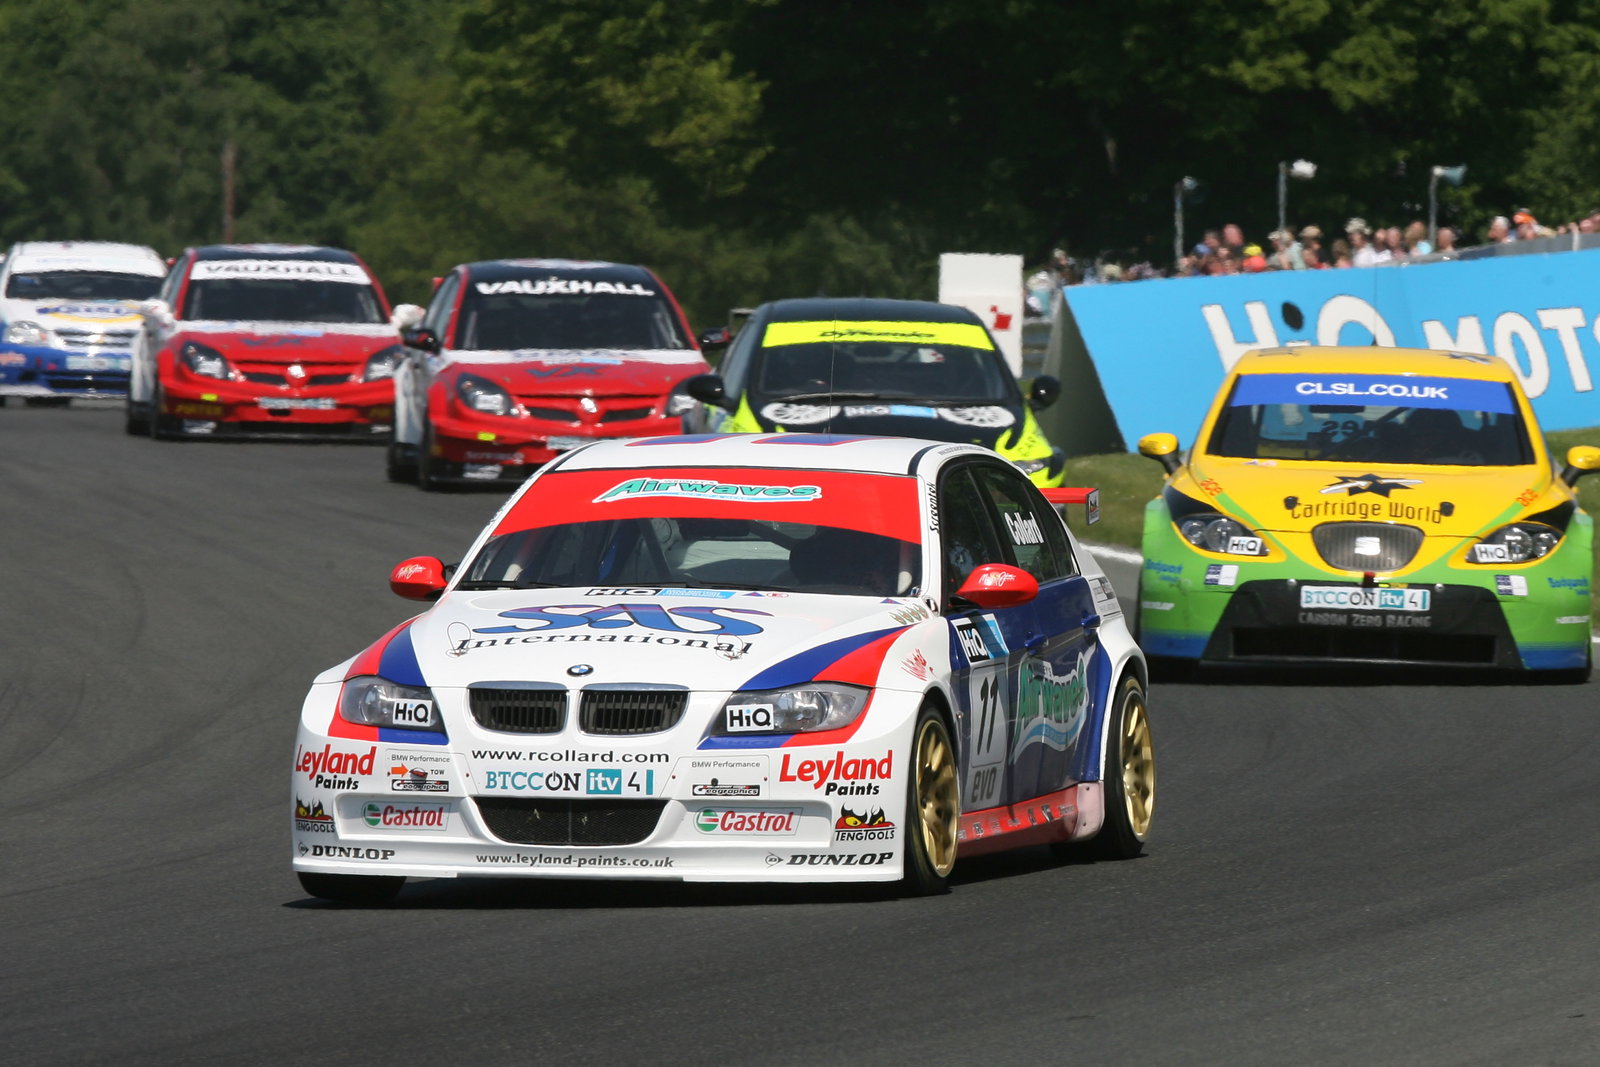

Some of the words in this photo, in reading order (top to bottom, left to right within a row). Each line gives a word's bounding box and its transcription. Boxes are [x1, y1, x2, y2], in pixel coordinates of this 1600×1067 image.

[205, 264, 352, 276] VAUXHALL
[475, 279, 655, 297] VAUXHALL
[1421, 306, 1600, 400] MOT
[1295, 382, 1449, 399] CLSL.CO.UK
[601, 479, 818, 500] Airwaves
[1200, 478, 1224, 497] ace
[1515, 488, 1539, 507] ace
[1291, 501, 1381, 519] Cartridge
[1388, 502, 1441, 524] World
[1004, 512, 1044, 546] Collard
[1231, 540, 1258, 552] HiQ
[1478, 547, 1506, 559] HiQ
[588, 588, 660, 596] HiQ
[1380, 591, 1404, 607] itv
[472, 604, 774, 636] SAS
[1299, 612, 1347, 626] CARBON
[1351, 614, 1383, 627] ZERO
[1386, 615, 1432, 628] RACING
[456, 632, 752, 655] International
[958, 628, 988, 657] HiQ
[395, 703, 428, 723] HiQ
[1012, 657, 1085, 753] Airwaves
[729, 708, 771, 727] HiQ
[977, 676, 999, 755] 11
[296, 744, 377, 780] Leyland
[471, 750, 670, 763] www.rcollard.com
[713, 760, 760, 768] Performance
[779, 750, 893, 790] Leyland
[315, 775, 359, 790] Paints
[589, 772, 620, 791] itv
[694, 785, 758, 796] Geographics
[825, 783, 880, 796] Paints
[971, 767, 997, 803] evo
[382, 805, 444, 827] Castrol
[720, 810, 795, 832] Castrol
[312, 844, 395, 860] DUNLOP
[476, 853, 674, 868] www.leyland-paints.co.uk
[786, 852, 894, 866] DUNLOP
